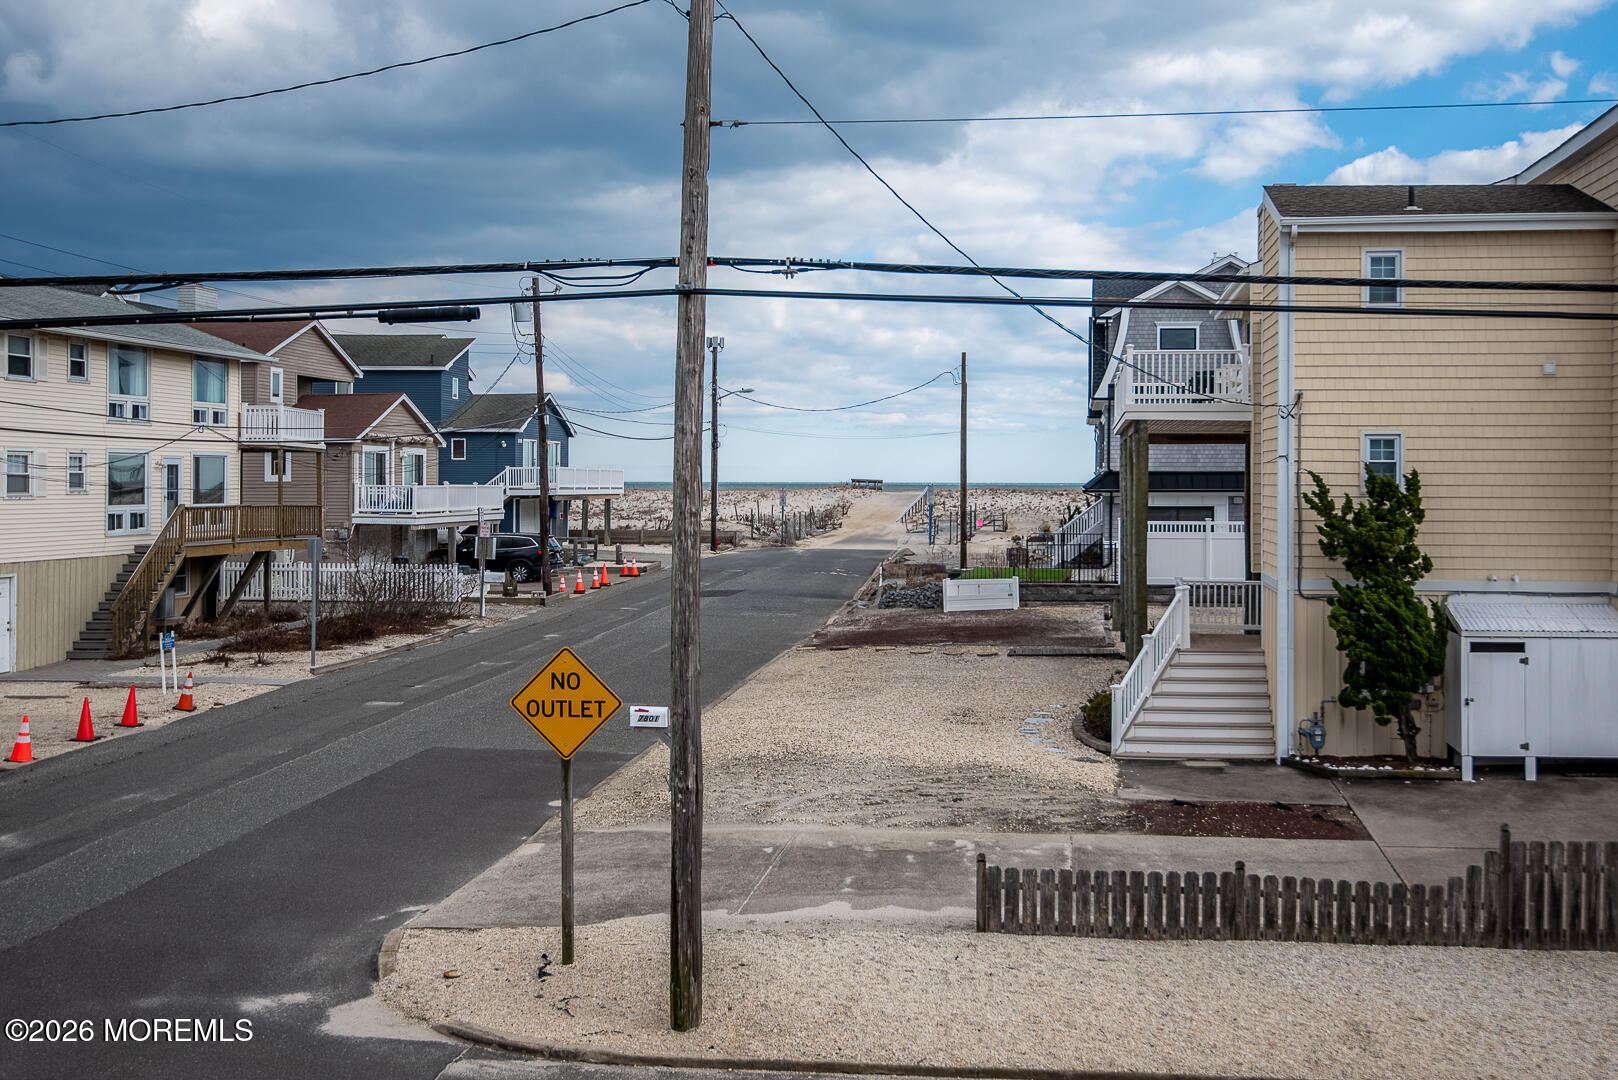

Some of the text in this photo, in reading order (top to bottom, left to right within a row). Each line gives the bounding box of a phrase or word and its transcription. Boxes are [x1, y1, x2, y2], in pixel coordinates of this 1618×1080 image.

[551, 672, 581, 690] NO
[526, 699, 606, 718] OUTLET
[637, 714, 660, 723] 7801
